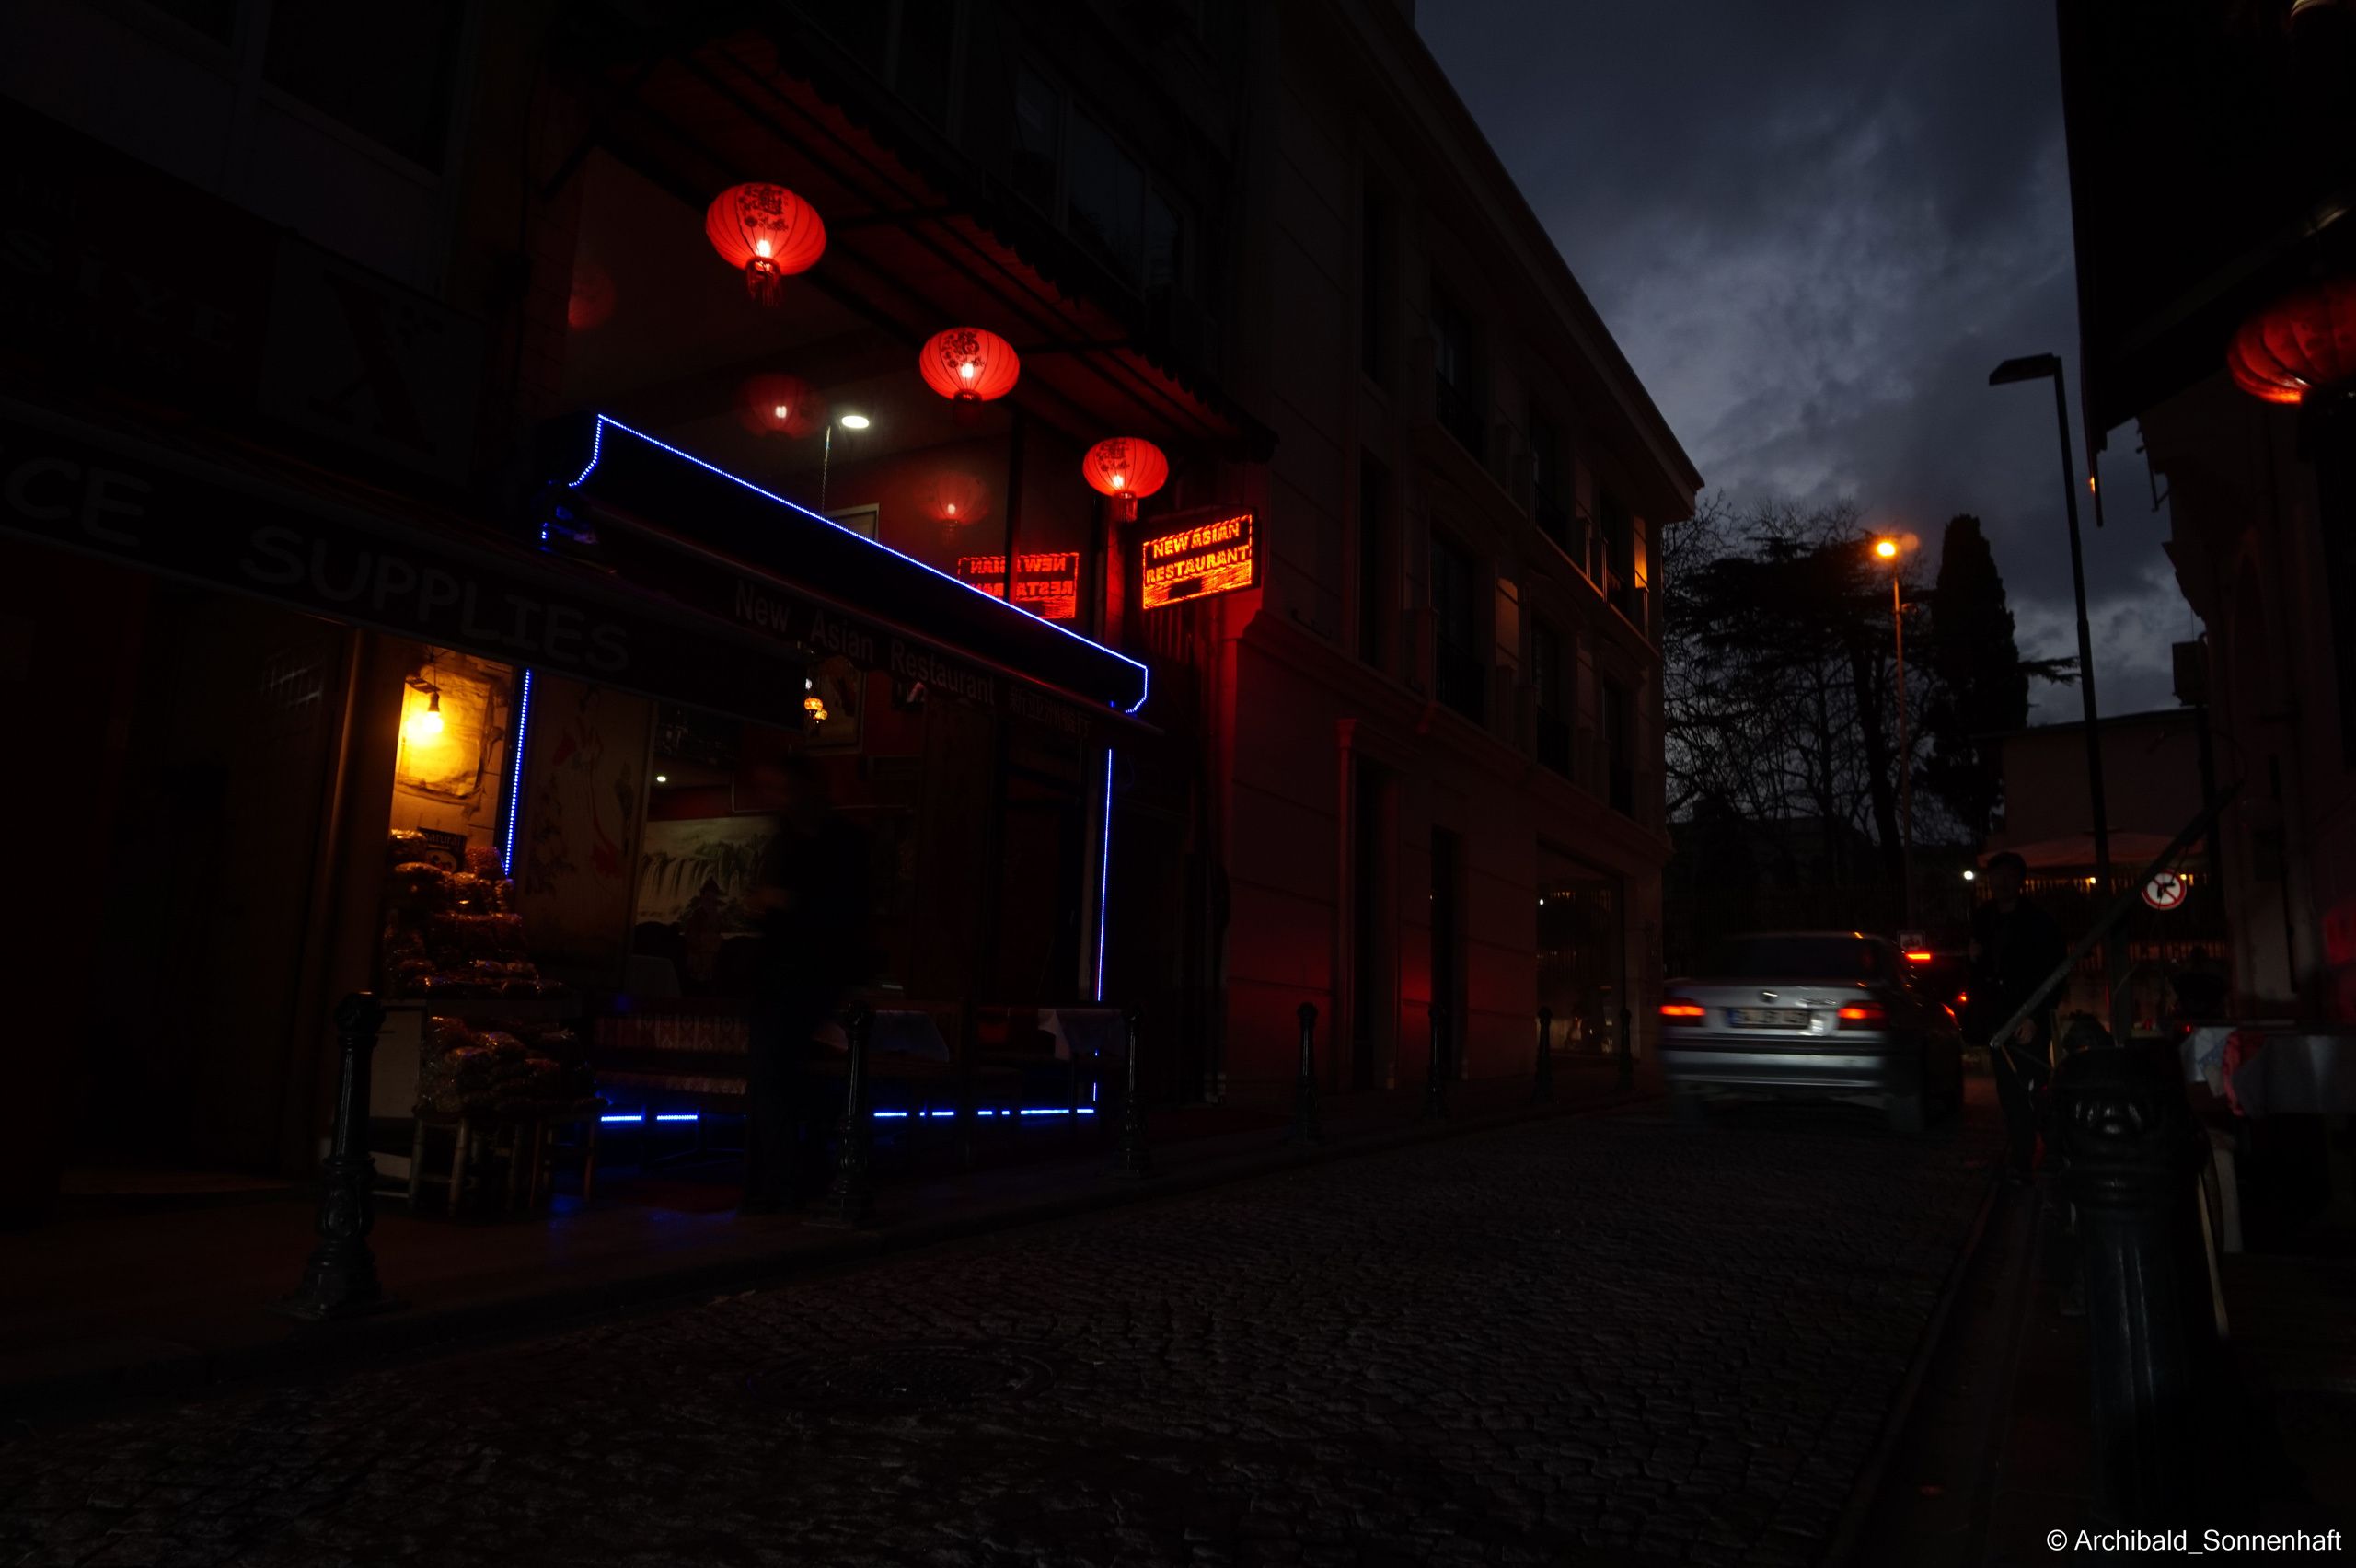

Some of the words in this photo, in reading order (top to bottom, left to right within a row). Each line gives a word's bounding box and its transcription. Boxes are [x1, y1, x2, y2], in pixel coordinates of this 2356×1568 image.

[0, 173, 79, 221] ERİ
[0, 442, 154, 548] CE
[237, 524, 630, 673] SUPPLIES
[1146, 544, 1250, 584] RESTAURANT
[1153, 536, 1189, 559] NEW
[1191, 522, 1240, 549] ASIAN
[735, 578, 791, 633] New
[809, 608, 874, 664] Asian
[890, 637, 996, 706] Restaurant
[1008, 684, 1092, 739] 新亚洲餐厅
